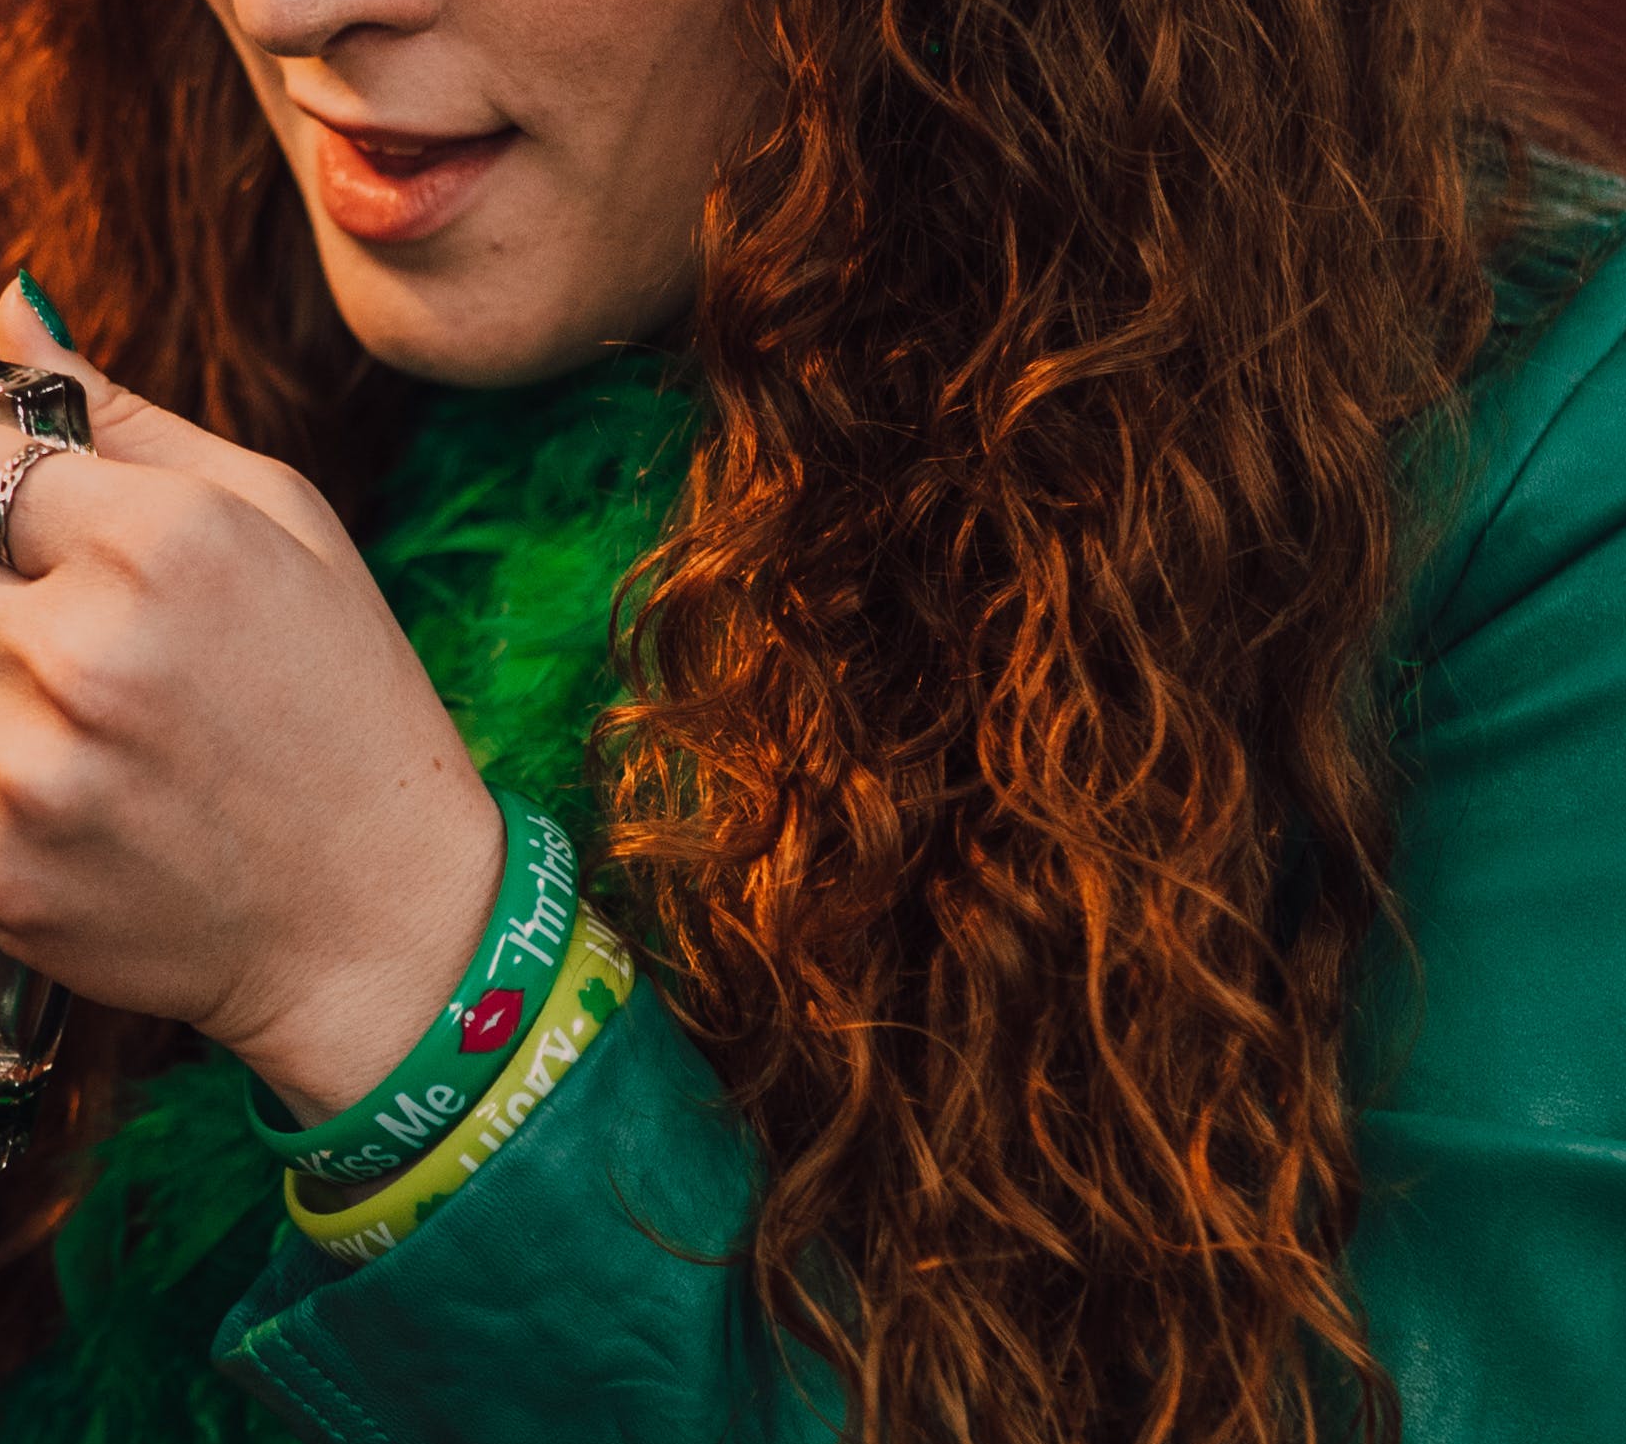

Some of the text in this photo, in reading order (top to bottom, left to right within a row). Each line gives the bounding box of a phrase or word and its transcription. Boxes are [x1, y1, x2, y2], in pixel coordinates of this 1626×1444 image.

[296, 814, 574, 1185] Kiss Me I'm Irish
